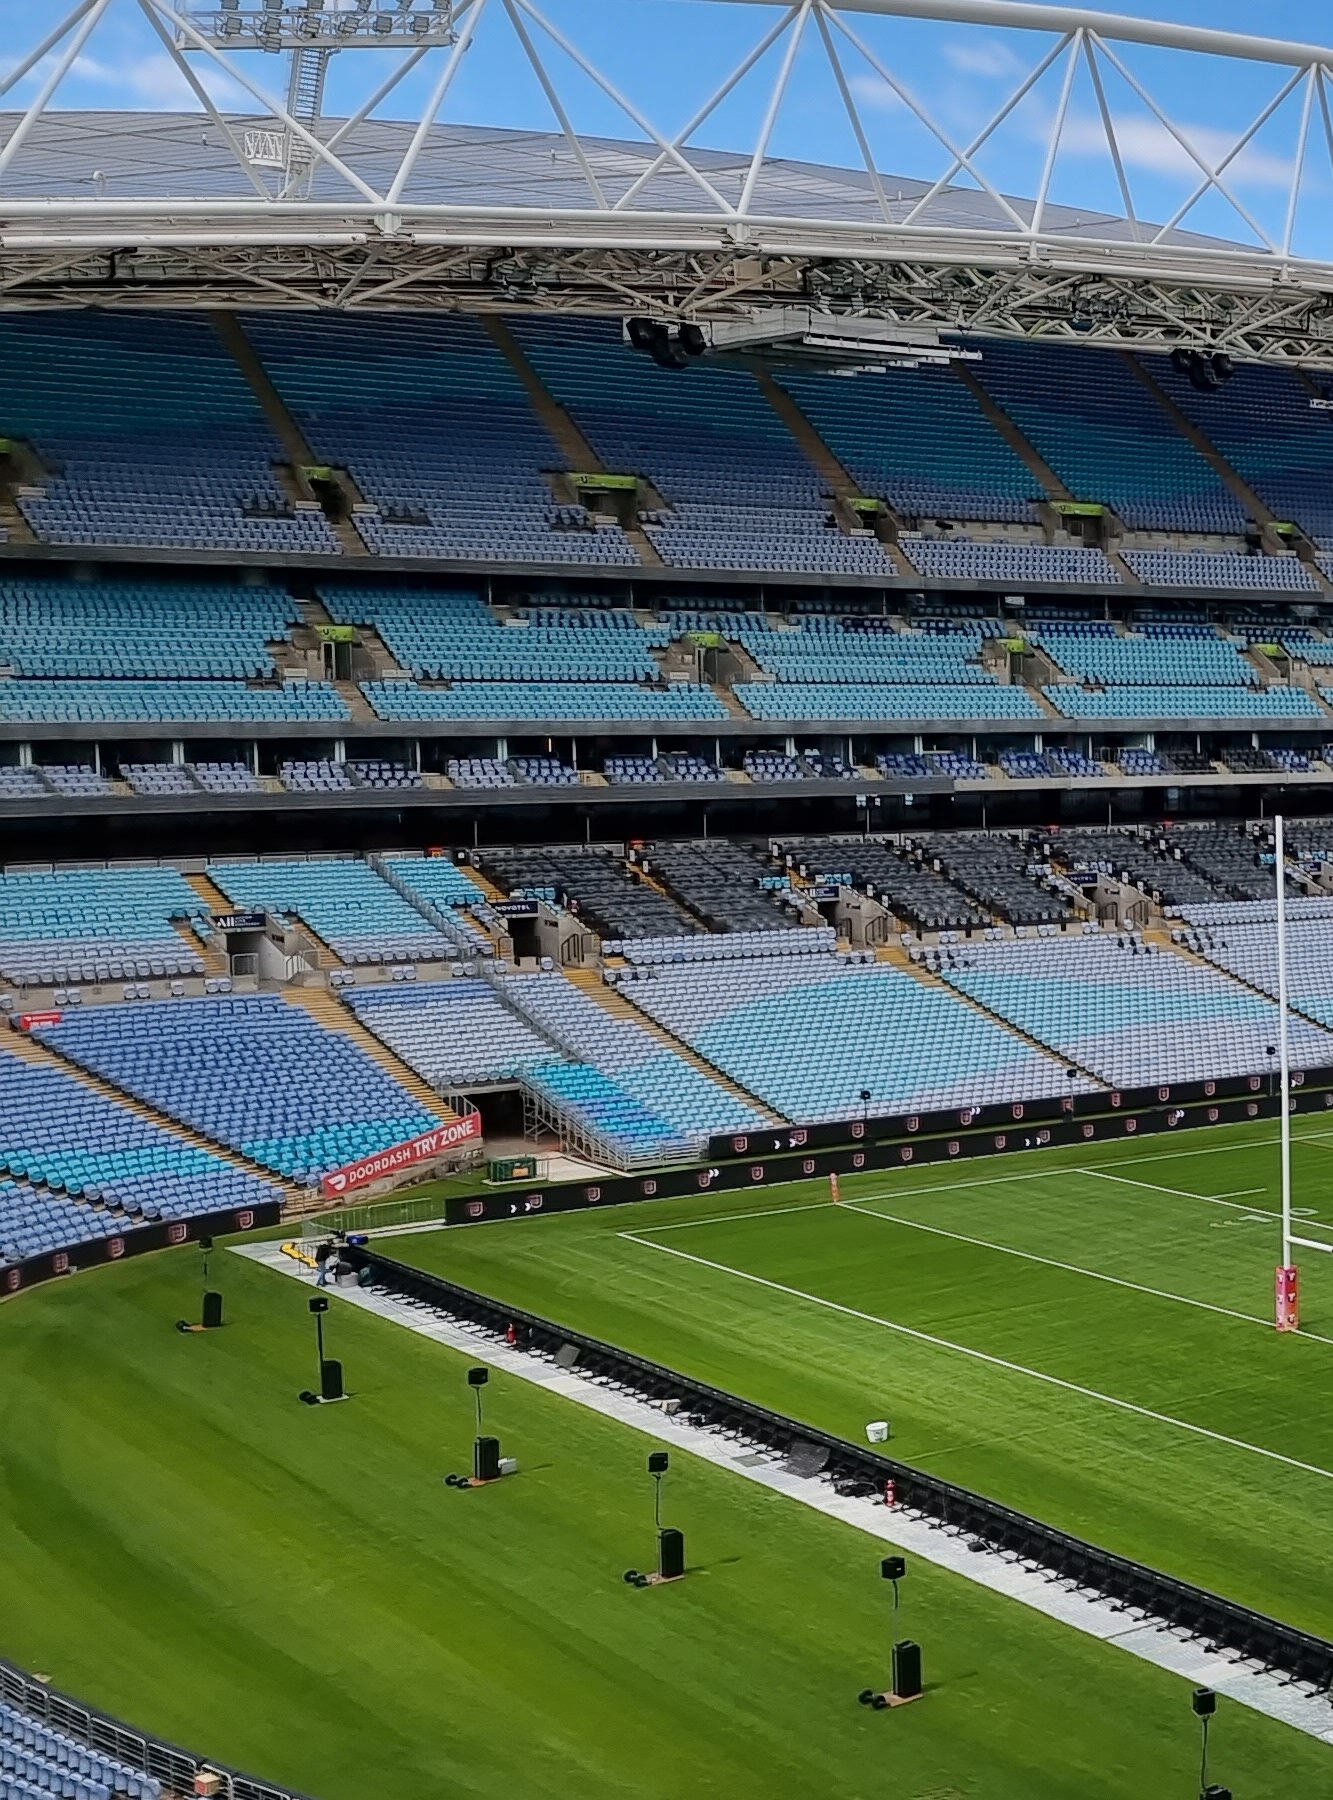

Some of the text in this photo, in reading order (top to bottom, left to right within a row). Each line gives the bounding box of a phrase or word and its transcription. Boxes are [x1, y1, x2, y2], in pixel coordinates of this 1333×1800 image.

[349, 1119, 475, 1183] DOORDASH TRY ZONE
